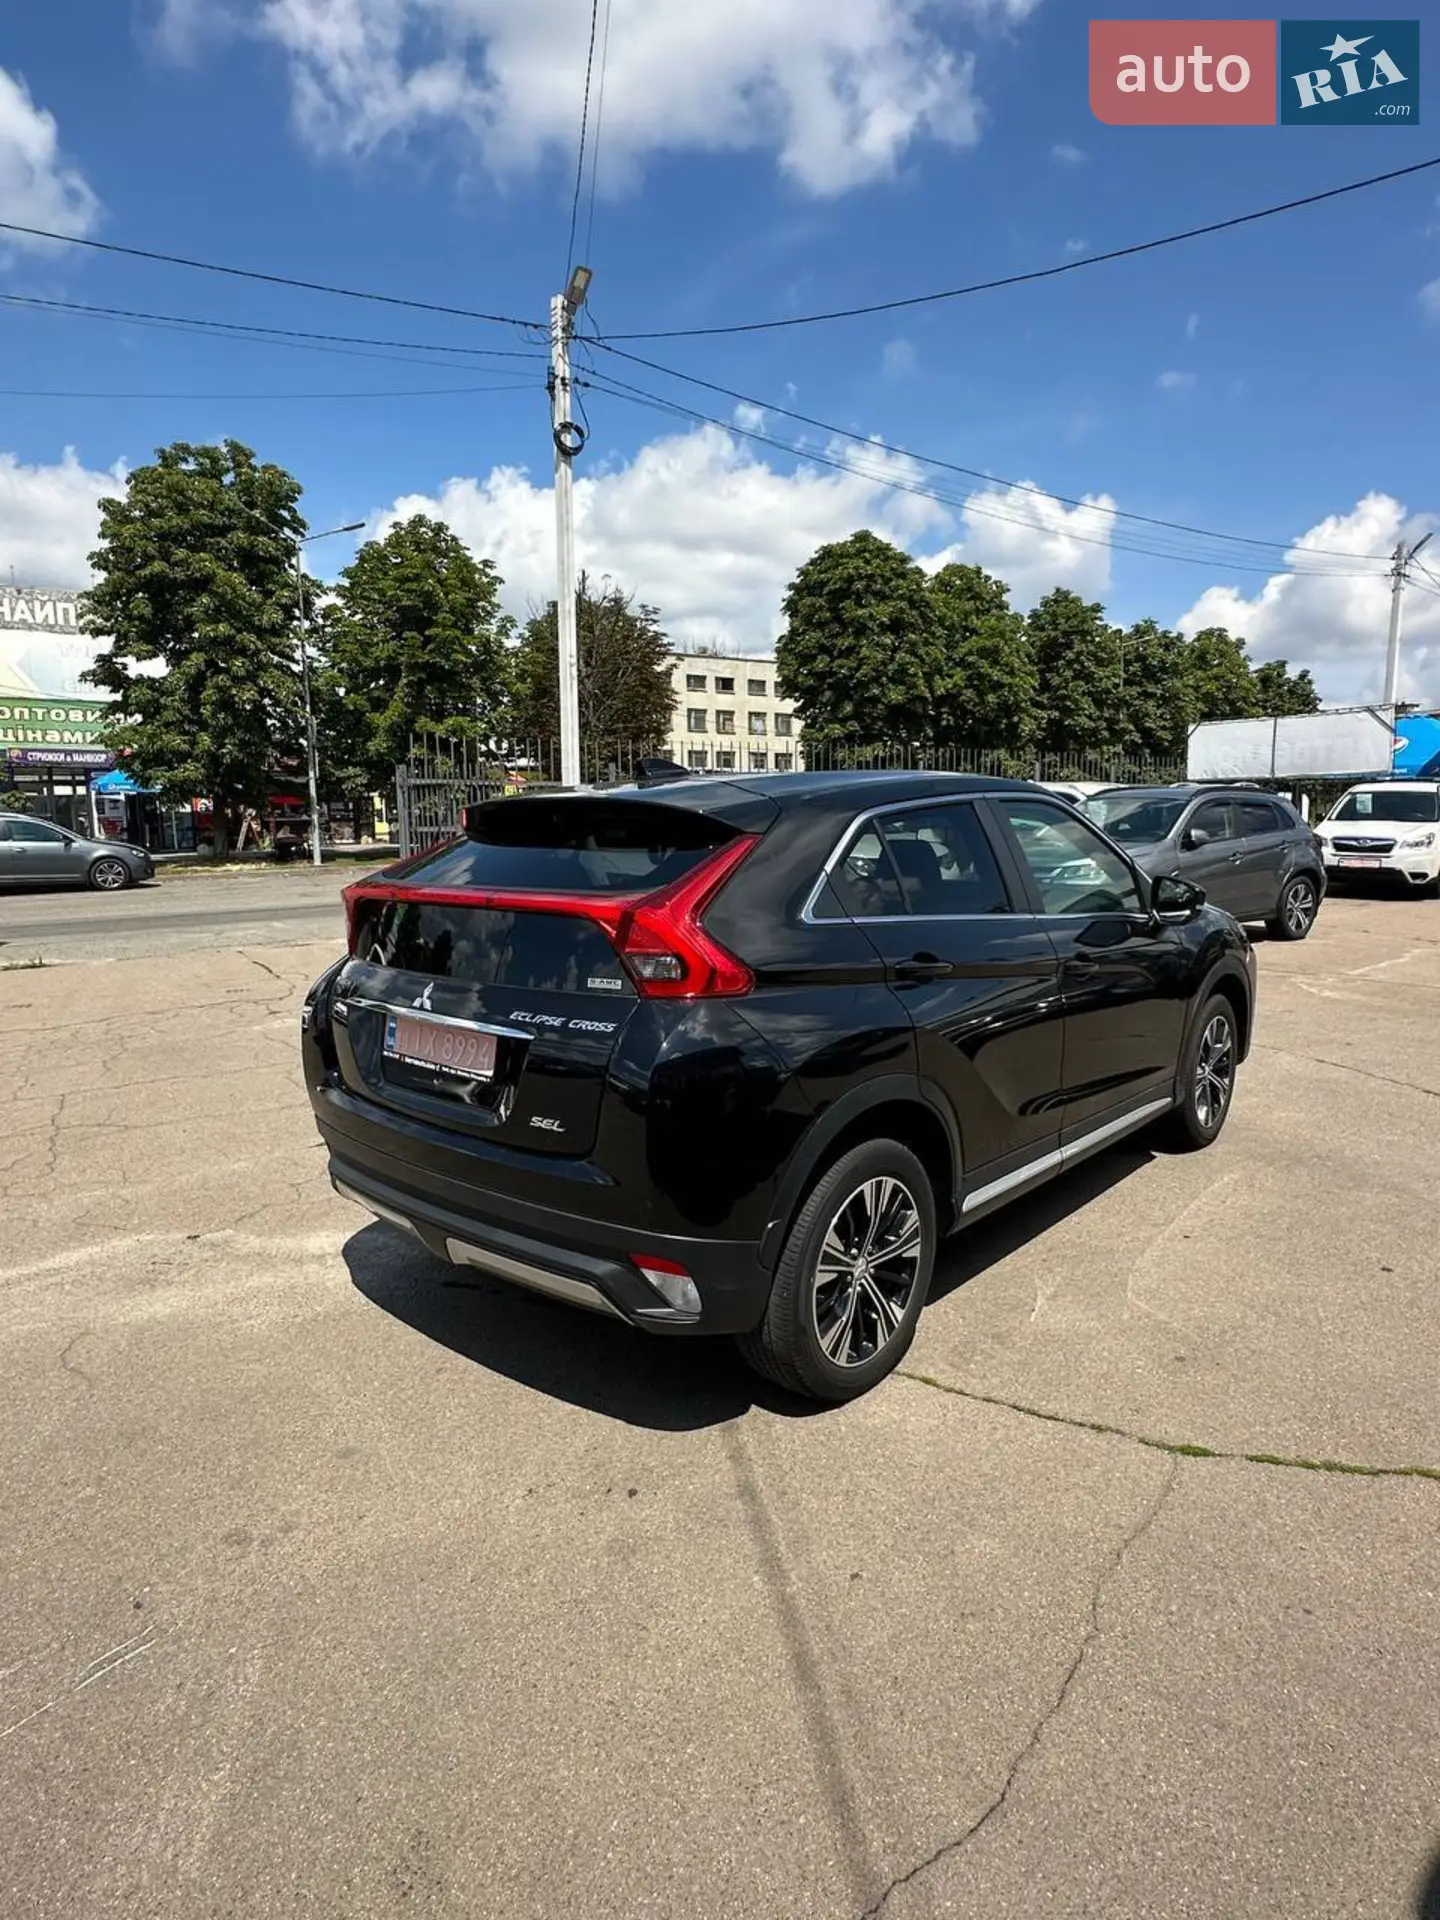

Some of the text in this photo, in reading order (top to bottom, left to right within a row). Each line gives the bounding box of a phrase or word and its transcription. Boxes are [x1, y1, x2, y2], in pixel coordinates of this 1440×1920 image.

[509, 1010, 619, 1033] ECLIPSE CROSS
[442, 1032, 489, 1070] 8994
[529, 1115, 567, 1132] SEL
